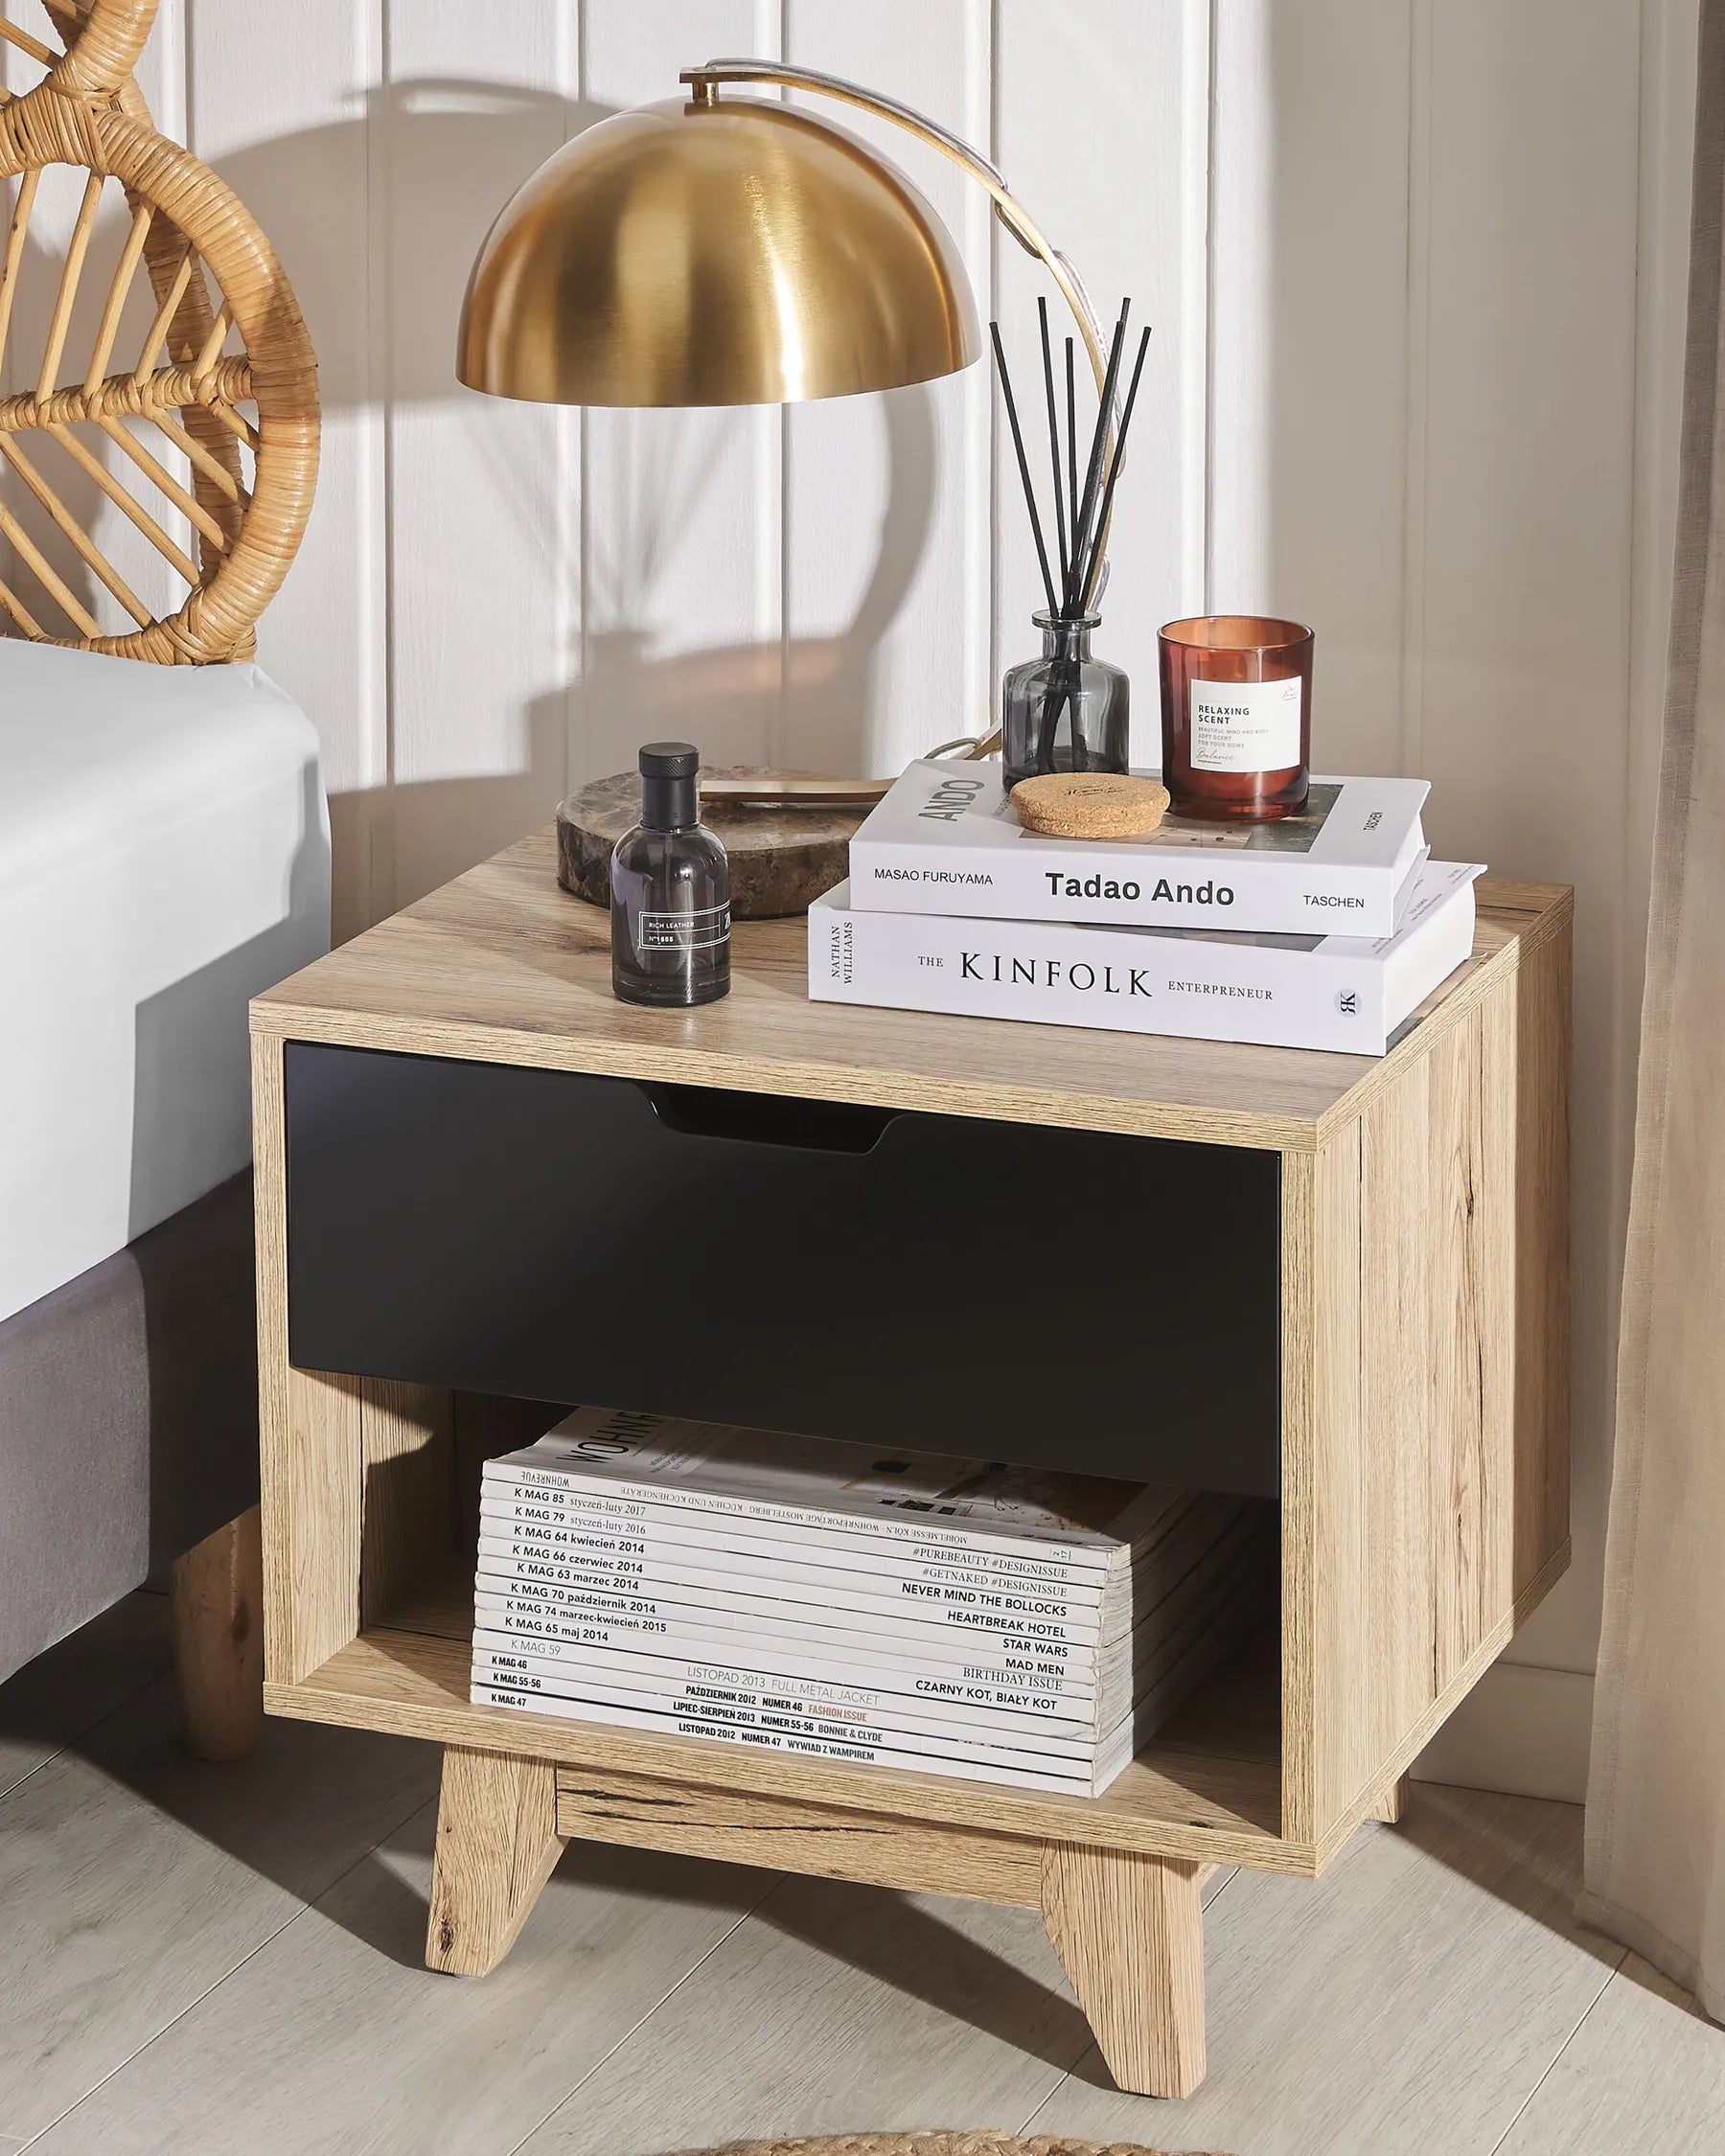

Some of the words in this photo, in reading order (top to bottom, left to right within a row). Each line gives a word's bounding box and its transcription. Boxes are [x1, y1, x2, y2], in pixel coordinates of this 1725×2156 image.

[1198, 704, 1250, 715] RELAXING
[1198, 715, 1230, 724] SCENT
[918, 780, 985, 822] ANDO
[874, 868, 920, 882] MASAO
[924, 872, 993, 885] FURUYAMA
[1045, 872, 1140, 900] Tadao
[1151, 879, 1234, 906] Ando
[1303, 895, 1365, 908] TASCHEN
[832, 926, 840, 977] NATHAN
[844, 922, 853, 984] WILLIAMS
[918, 956, 944, 968] THE
[960, 952, 1153, 997] KINFOLK
[1168, 980, 1274, 1000] ENTERPRENEUR
[521, 1471, 569, 1487] WOHNREVUE
[514, 1487, 521, 1497] K
[524, 1490, 549, 1502] MAG
[552, 1495, 564, 1503] 85
[570, 1499, 623, 1513] styczeń-luty
[625, 1504, 646, 1516] 2017
[688, 1497, 706, 1506] UND
[749, 1506, 805, 1521] MOSTELBERG
[515, 1506, 522, 1516] K
[525, 1508, 549, 1520] MAG
[553, 1512, 565, 1523] 79
[570, 1516, 623, 1531] styczeń-luty
[625, 1524, 646, 1534] 2016
[806, 1514, 880, 1532] WOHNREPORTAGE
[515, 1525, 522, 1535] K
[525, 1527, 551, 1540] MAG
[555, 1532, 567, 1542] 64
[571, 1533, 615, 1549] kwiecień
[618, 1541, 645, 1553] 2014
[513, 1545, 520, 1554] K
[523, 1547, 550, 1559] MAG
[553, 1551, 565, 1561] 66
[569, 1554, 613, 1569] czerwiec
[617, 1561, 643, 1573] 2014
[912, 1548, 989, 1566] #PUREBEAUTY
[991, 1559, 1068, 1578] #DESIGNISSUE
[518, 1563, 525, 1572] K
[528, 1565, 554, 1577] MAG
[558, 1570, 570, 1580] 63
[573, 1573, 610, 1586] marzec
[613, 1578, 639, 1591] 2014
[922, 1568, 989, 1585] #GETNAKED
[991, 1578, 1067, 1596] #DESIGNISSUE
[511, 1583, 518, 1593] K
[521, 1585, 548, 1597] MAG
[552, 1590, 564, 1599] 70
[568, 1593, 627, 1610] październik
[631, 1602, 656, 1614] 2014
[902, 1583, 941, 1597] NEVER
[944, 1589, 977, 1603] MIND
[979, 1594, 1001, 1607] THE
[1005, 1598, 1067, 1617] BOLLOCKS
[505, 1617, 513, 1626] K
[517, 1618, 542, 1631] MAG
[545, 1623, 558, 1634] 65
[562, 1628, 580, 1640] maj
[583, 1629, 609, 1641] 2014
[507, 1600, 514, 1610] K
[518, 1602, 541, 1615] MAG
[545, 1606, 557, 1616] 74
[560, 1610, 639, 1629] marzec-kwiecień
[642, 1620, 667, 1632] 2015
[948, 1610, 1024, 1631] HEARTBREAK
[1027, 1623, 1067, 1638] HOTEL
[511, 1639, 518, 1648] K
[521, 1640, 545, 1654] MAG
[549, 1645, 561, 1656] 59
[1002, 1638, 1031, 1652] STAR
[1035, 1642, 1069, 1658] WARS
[492, 1656, 497, 1664] K
[499, 1657, 517, 1667] MAG
[518, 1660, 527, 1669] 46
[1005, 1658, 1033, 1671] MAD
[1037, 1663, 1065, 1676] MEN
[494, 1673, 499, 1682] K
[500, 1674, 518, 1685] MAG
[519, 1677, 540, 1688] 55-56
[687, 1666, 740, 1683] LISTOPAD
[742, 1675, 766, 1687] 2013
[772, 1679, 796, 1692] FULL
[799, 1684, 835, 1699] METAL
[838, 1690, 880, 1706] JACKET
[963, 1667, 1025, 1686] BIRTHDAY
[1029, 1677, 1063, 1690] ISSUE
[492, 1693, 497, 1702] K
[498, 1694, 516, 1705] MAG
[517, 1697, 526, 1707] 47
[738, 1693, 756, 1705] 2012
[763, 1697, 792, 1710] NUMER
[793, 1702, 803, 1711] 46
[809, 1705, 842, 1718] FASHION
[844, 1709, 867, 1722] ISSUE
[915, 1680, 963, 1696] CZARNY
[967, 1687, 993, 1702] KOT,
[997, 1692, 1029, 1707] BIAŁY
[1032, 1698, 1058, 1710] KOT
[673, 1701, 736, 1719] LIPIEC-SIERPIEŃ
[737, 1711, 755, 1722] 2013
[761, 1715, 790, 1728] NUMER
[791, 1720, 814, 1732] 55-56
[818, 1725, 848, 1737] BONNIE
[849, 1729, 857, 1738] &
[858, 1731, 883, 1742] CLYDE
[678, 1723, 716, 1736] LISTOPAD
[717, 1729, 735, 1739] 2012
[742, 1732, 770, 1745] NUMER
[771, 1738, 781, 1747] 47
[788, 1739, 821, 1752] WYWIAD
[823, 1745, 828, 1754] Z
[829, 1746, 875, 1761] WAMPIREM
